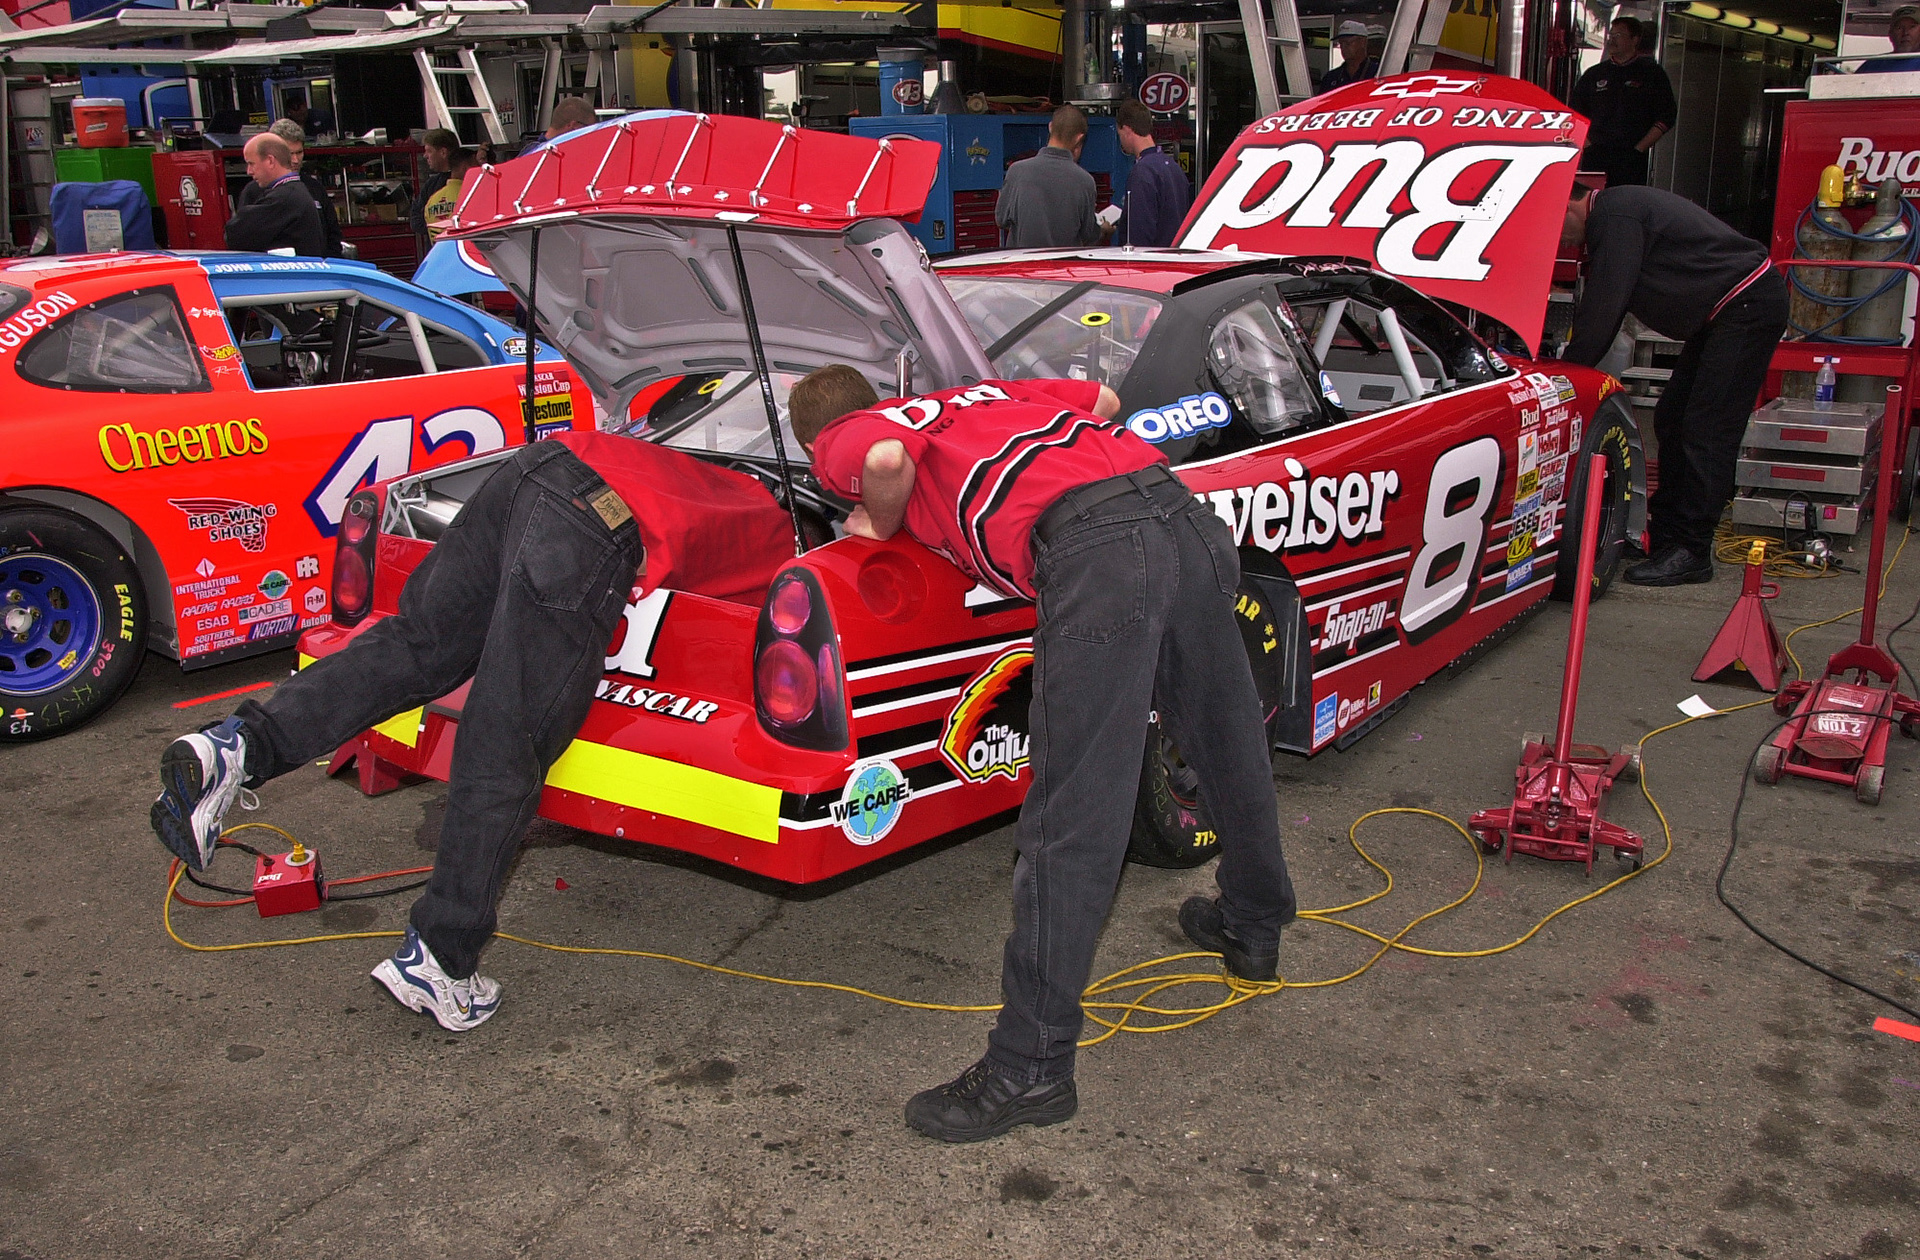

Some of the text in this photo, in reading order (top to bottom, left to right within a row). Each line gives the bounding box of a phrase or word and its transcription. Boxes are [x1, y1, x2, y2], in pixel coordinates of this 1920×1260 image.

[1145, 78, 1182, 105] STP
[1257, 107, 1575, 134] KING OF BEERS
[1178, 140, 1580, 282] Bud
[214, 260, 330, 273] JOHN ANDRETTI
[533, 372, 555, 381] ASCAR
[517, 379, 571, 397] Wston Cup
[520, 400, 572, 421] Pestone
[1129, 396, 1230, 440] OREO
[1521, 404, 1539, 428] Bud
[927, 417, 955, 437] NG
[98, 418, 270, 473] Cheerios
[1193, 457, 1399, 553] weiser
[188, 504, 277, 529] RED WING
[209, 522, 260, 541] SHOES
[1399, 437, 1500, 632] 8
[175, 575, 241, 595] INTERNATIONAL
[193, 587, 226, 600] TRUCKS
[113, 583, 135, 643] EAGLE
[181, 601, 218, 618] RACING
[249, 599, 289, 618] CADRE
[197, 614, 230, 631] ESAB
[251, 615, 297, 640] NORTON
[1320, 602, 1388, 651] Snap-on
[185, 634, 247, 656] PRIDE TRUCKING
[194, 628, 235, 644] SOUTHERN
[1262, 622, 1278, 655] #1
[10, 720, 32, 735] 43
[984, 723, 1009, 743] The
[1817, 719, 1861, 734] 2 TON
[834, 799, 860, 822] WE
[1192, 830, 1218, 848] GLE
